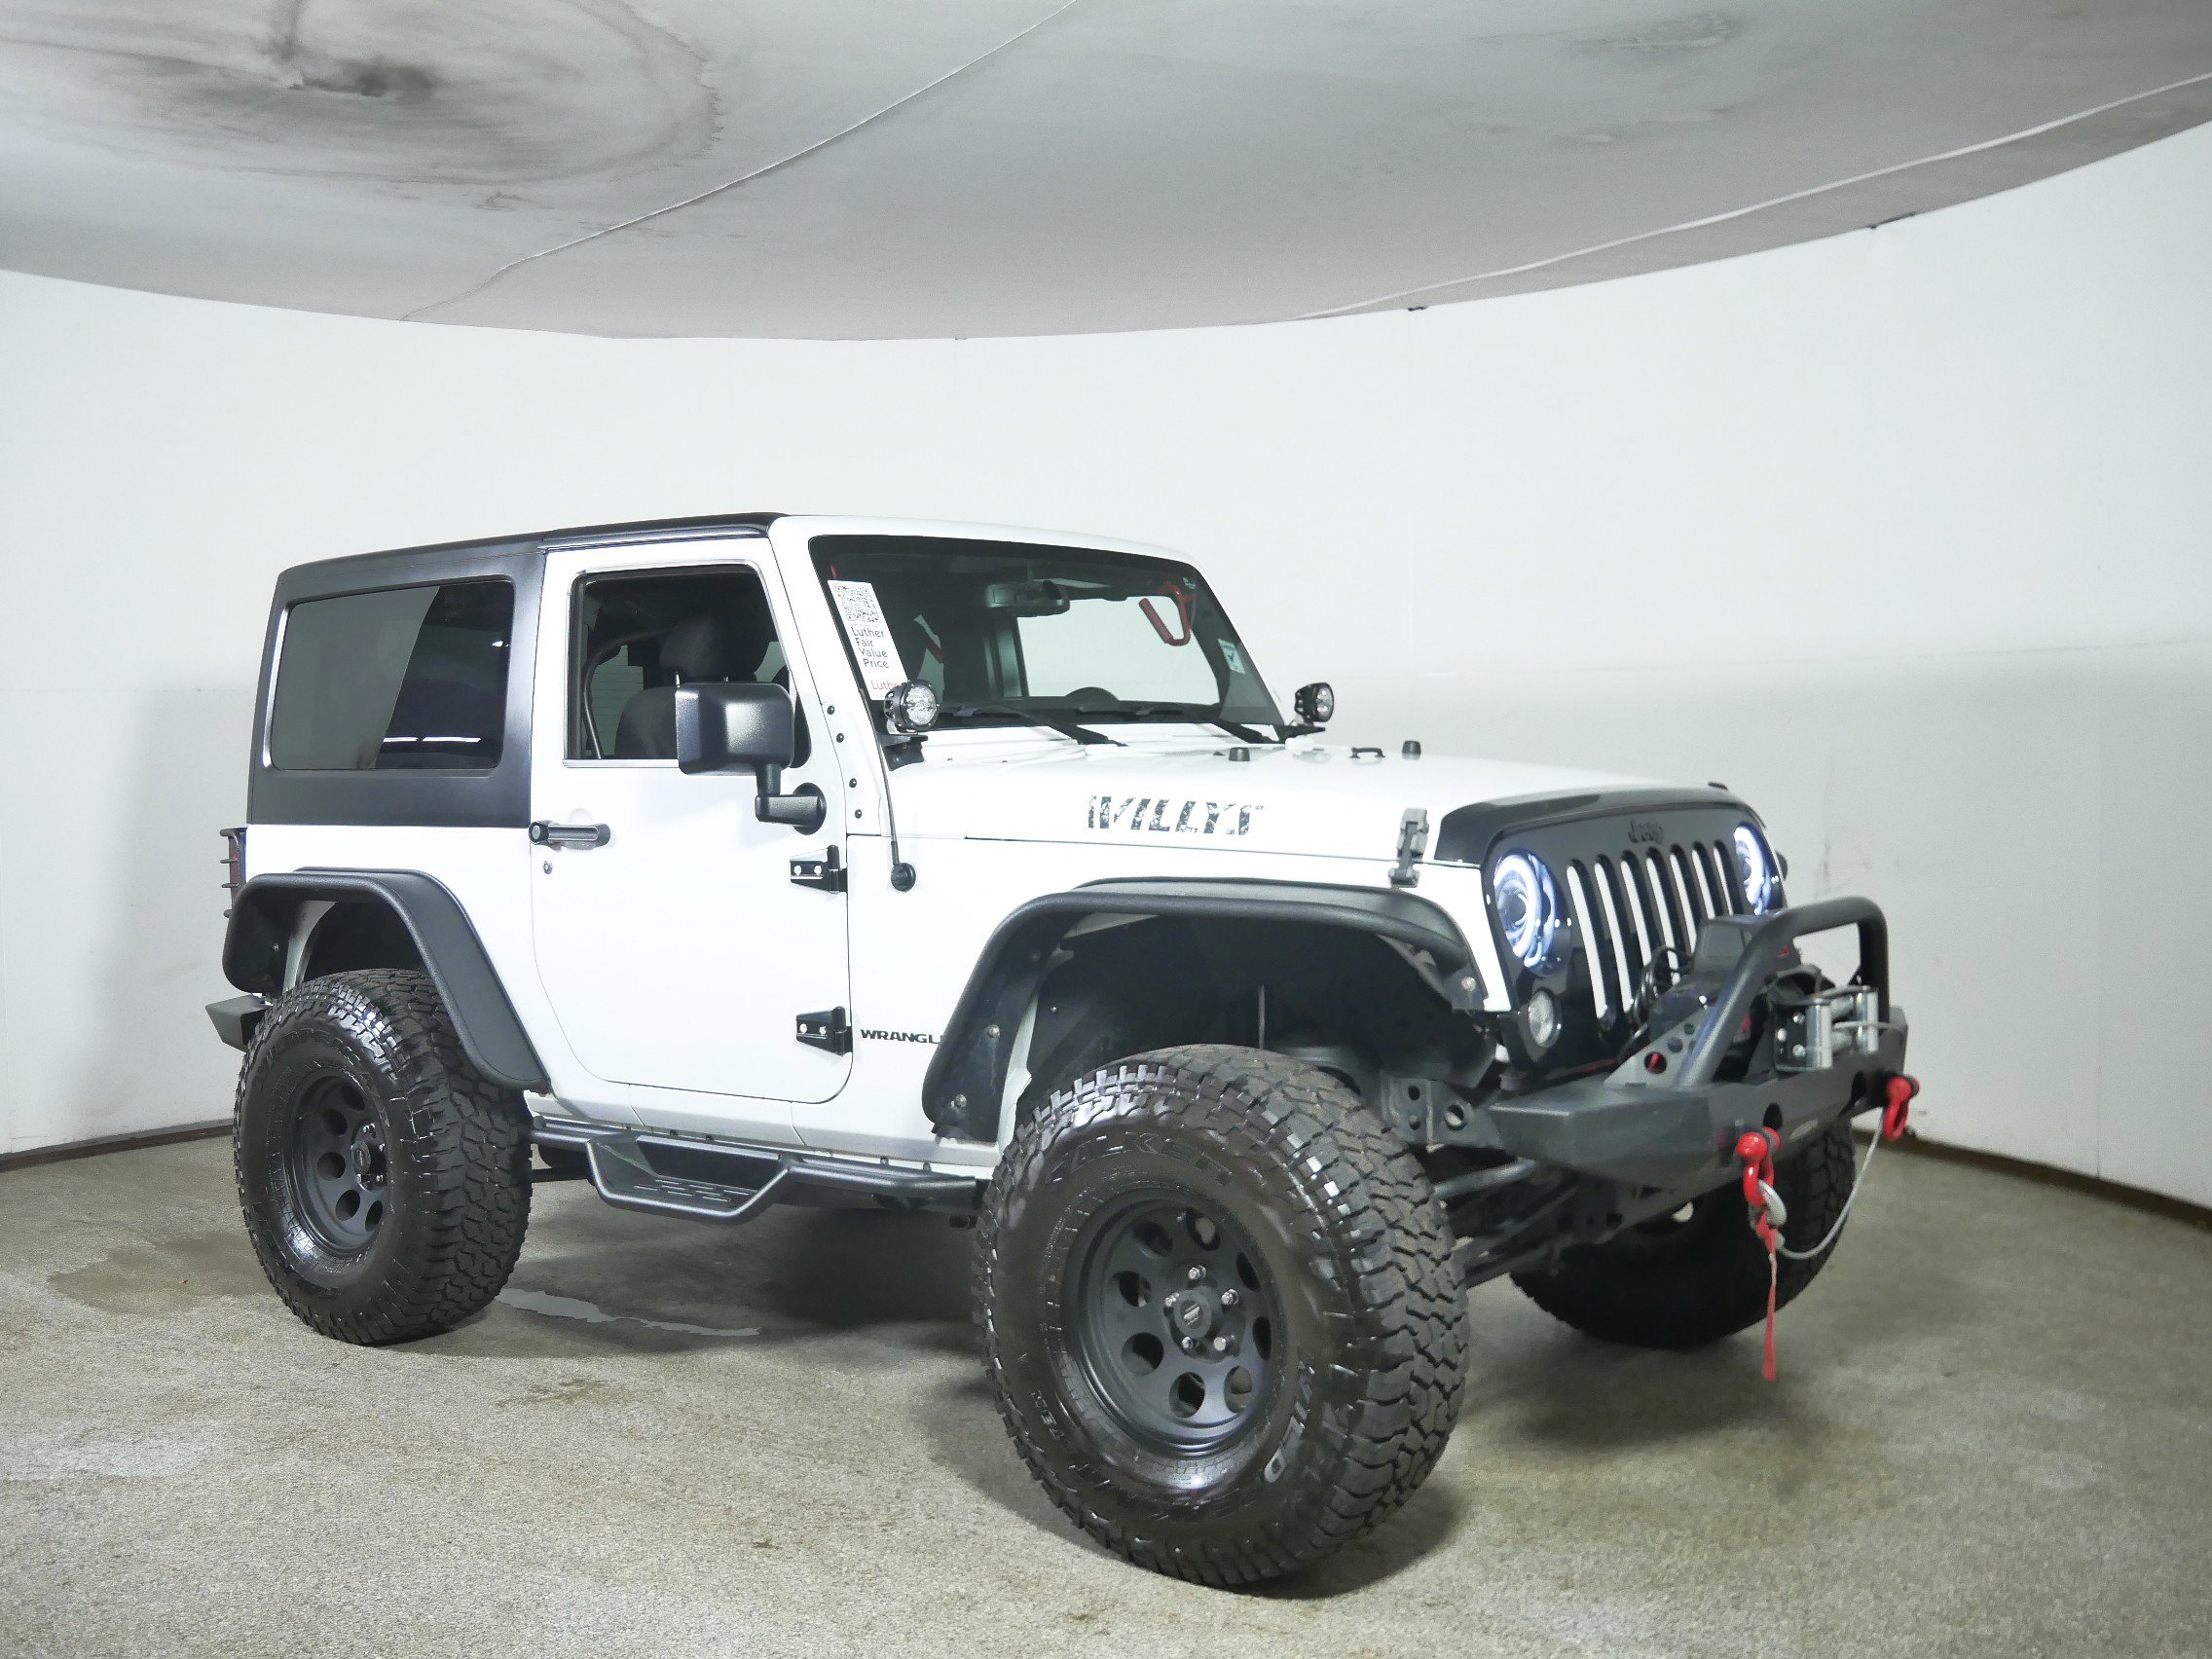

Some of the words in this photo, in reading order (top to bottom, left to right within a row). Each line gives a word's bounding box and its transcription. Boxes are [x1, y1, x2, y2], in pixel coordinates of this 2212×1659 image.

[851, 627, 885, 638] Luther
[855, 638, 873, 647] Fair
[859, 647, 888, 658] Value
[862, 658, 890, 669] Price
[860, 1028, 942, 1045] WRANGL
